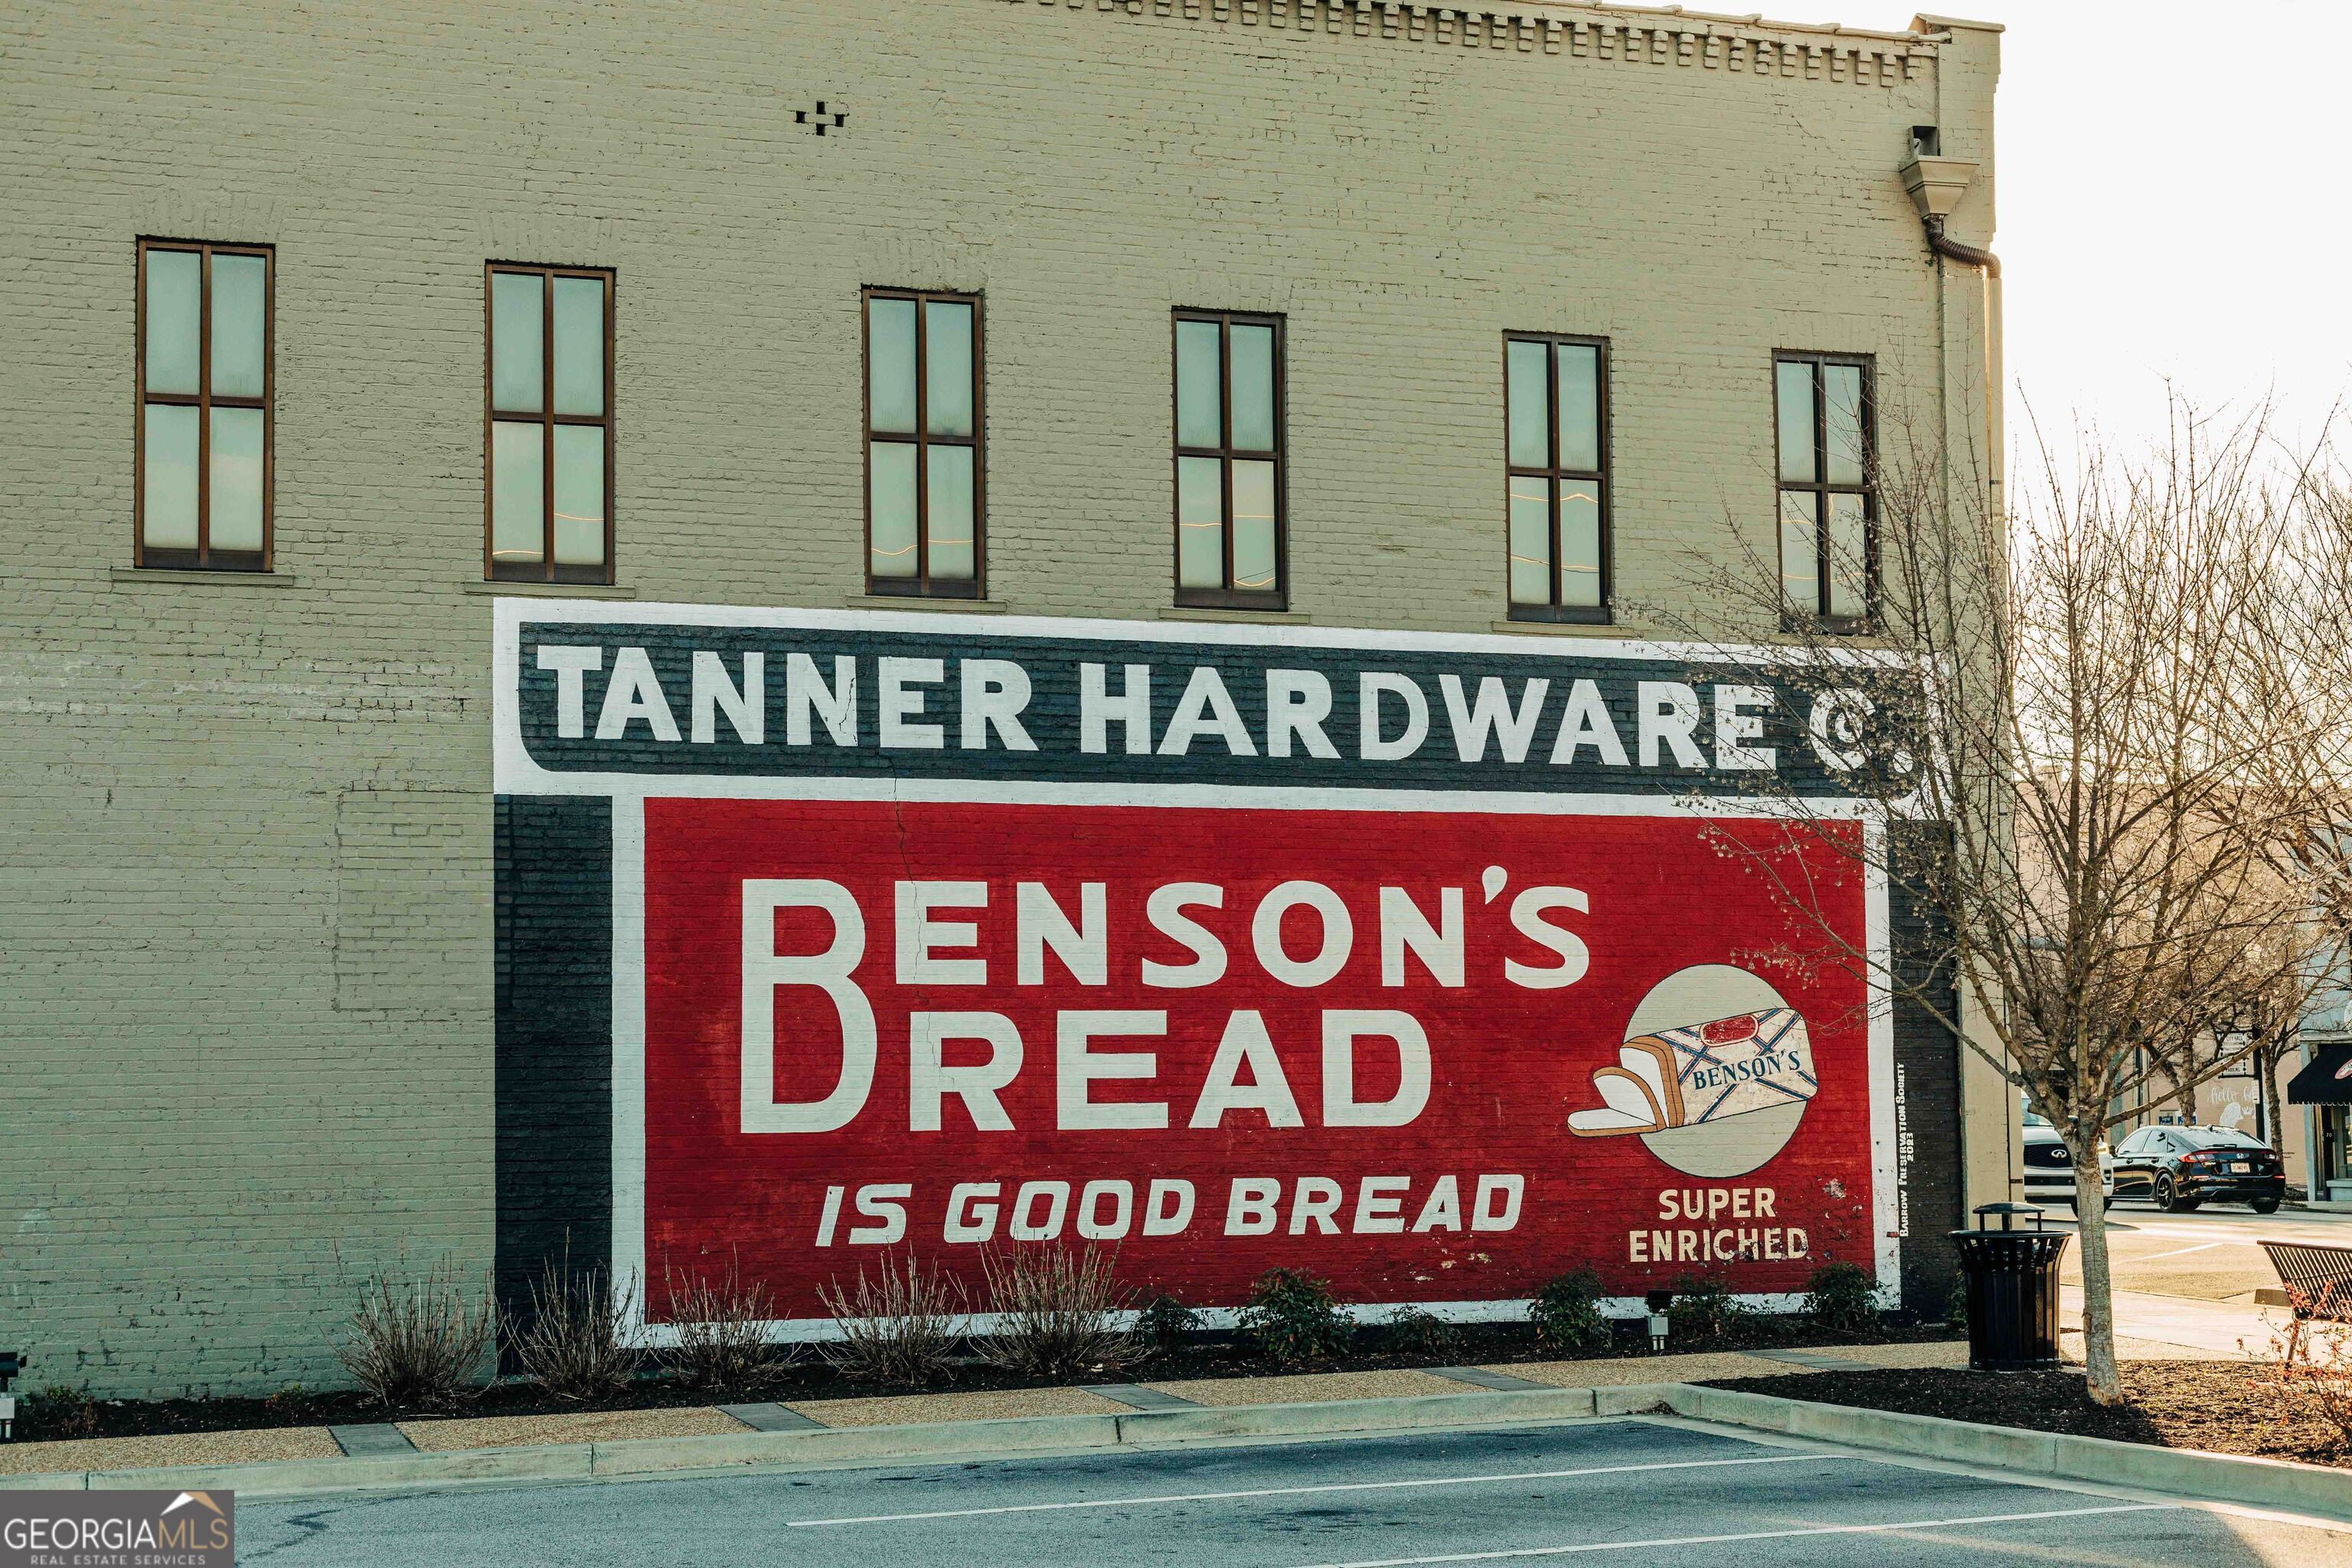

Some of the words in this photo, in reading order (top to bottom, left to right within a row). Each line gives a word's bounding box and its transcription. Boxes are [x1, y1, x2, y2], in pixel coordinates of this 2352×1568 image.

[537, 645, 1039, 752] TANNER
[1080, 662, 1777, 770] HARDWARE
[1693, 1049, 1801, 1090] BENSON'S
[1896, 1063, 1905, 1104] SOCIETY
[1898, 1105, 1908, 1185] PRESERVATION
[815, 1183, 913, 1246] IS
[943, 1178, 1196, 1243] GOOD
[1223, 1174, 1524, 1236] BREAD
[1659, 1187, 1776, 1221] SUPER
[1899, 1190, 1909, 1237] BARROW
[1629, 1227, 1809, 1263] ENRICHED
